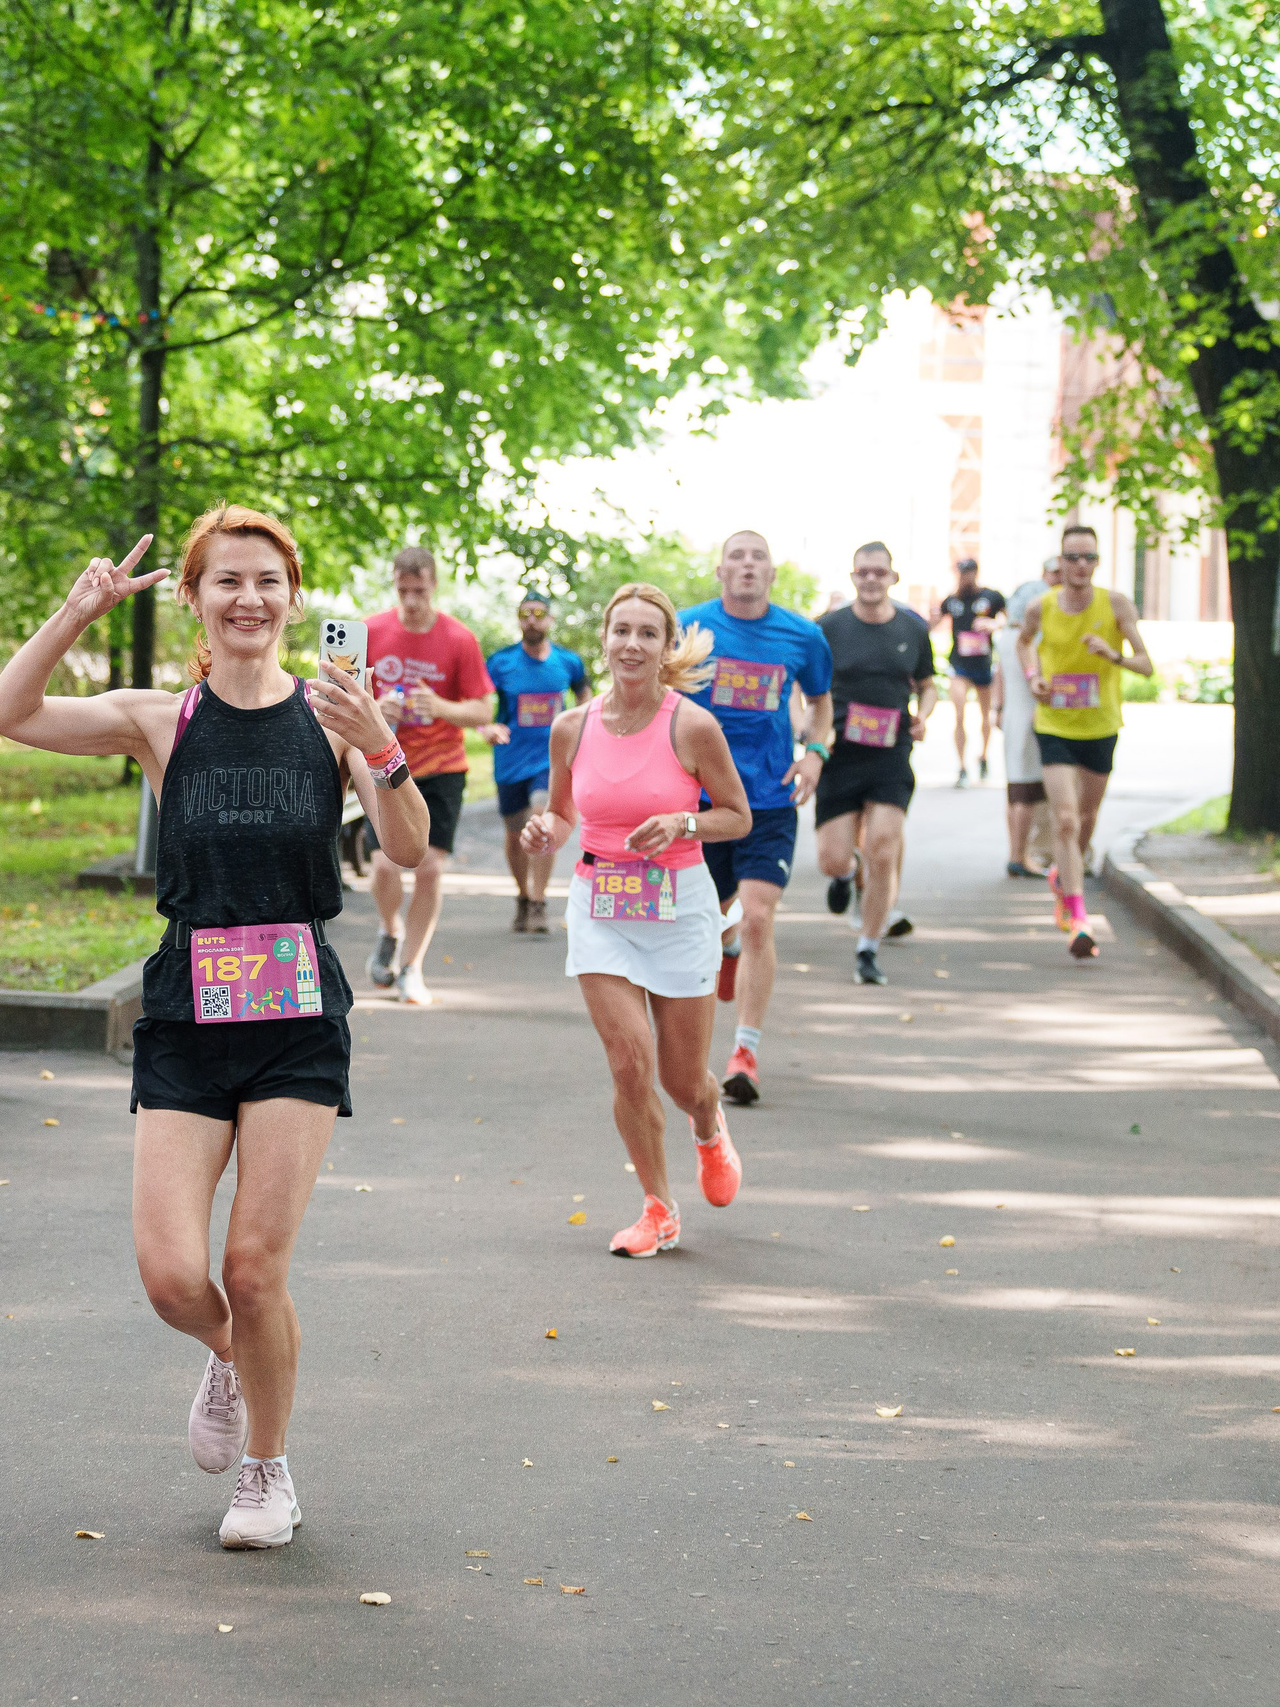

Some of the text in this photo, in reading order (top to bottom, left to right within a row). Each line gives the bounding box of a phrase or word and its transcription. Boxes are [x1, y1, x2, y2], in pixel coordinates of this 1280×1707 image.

[183, 767, 317, 826] VICTORIA
[218, 810, 275, 824] SPORT
[595, 875, 642, 894] 188
[197, 937, 226, 945] RUTS
[280, 941, 290, 952] 2
[198, 954, 268, 982] 187
